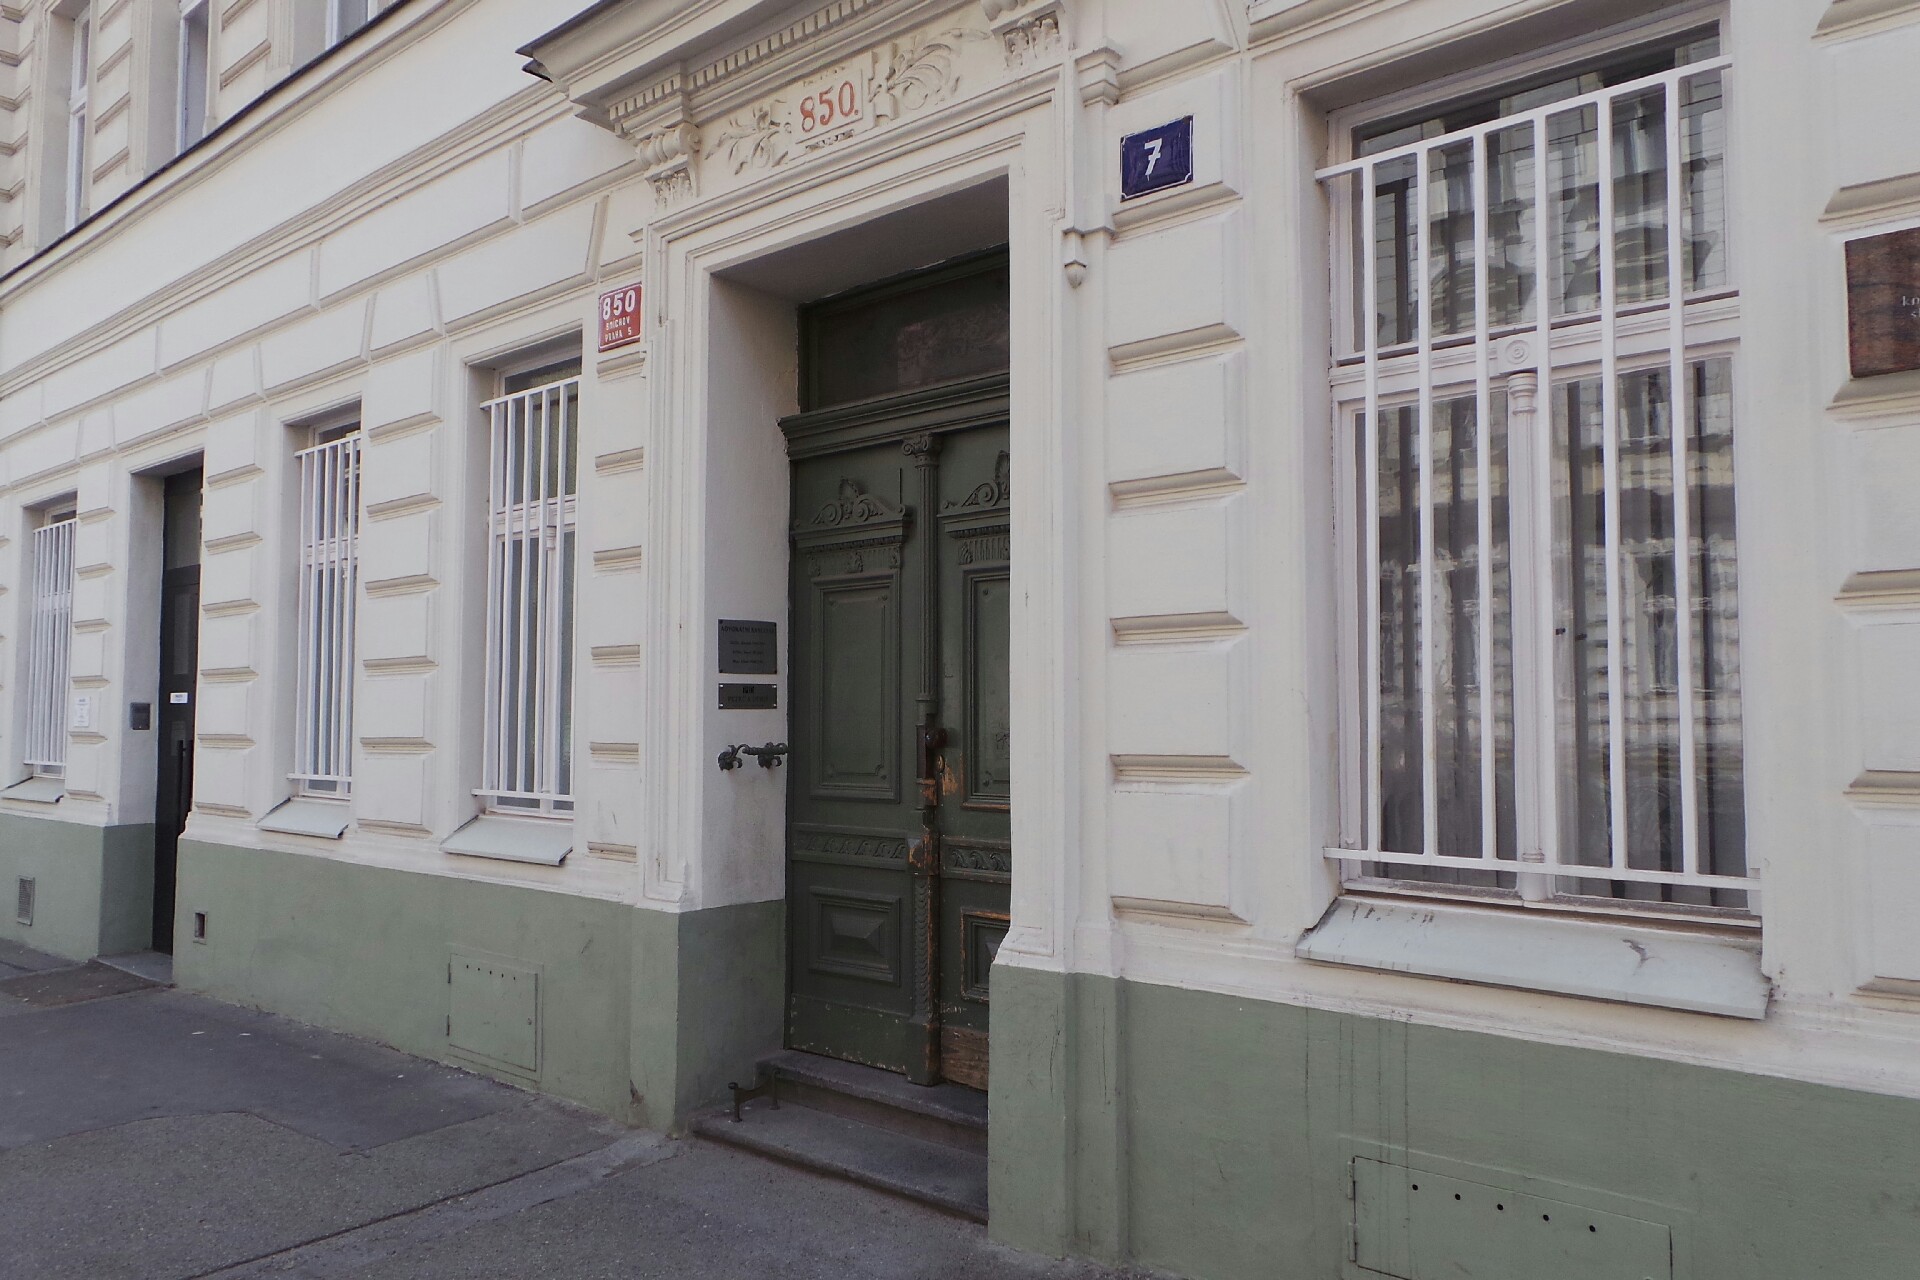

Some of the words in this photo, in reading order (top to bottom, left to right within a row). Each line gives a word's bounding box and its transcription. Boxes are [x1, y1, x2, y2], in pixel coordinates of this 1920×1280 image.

[1144, 138, 1163, 177] 7
[602, 289, 636, 320] 850
[604, 329, 623, 343] PRAHA
[627, 326, 632, 336] 5
